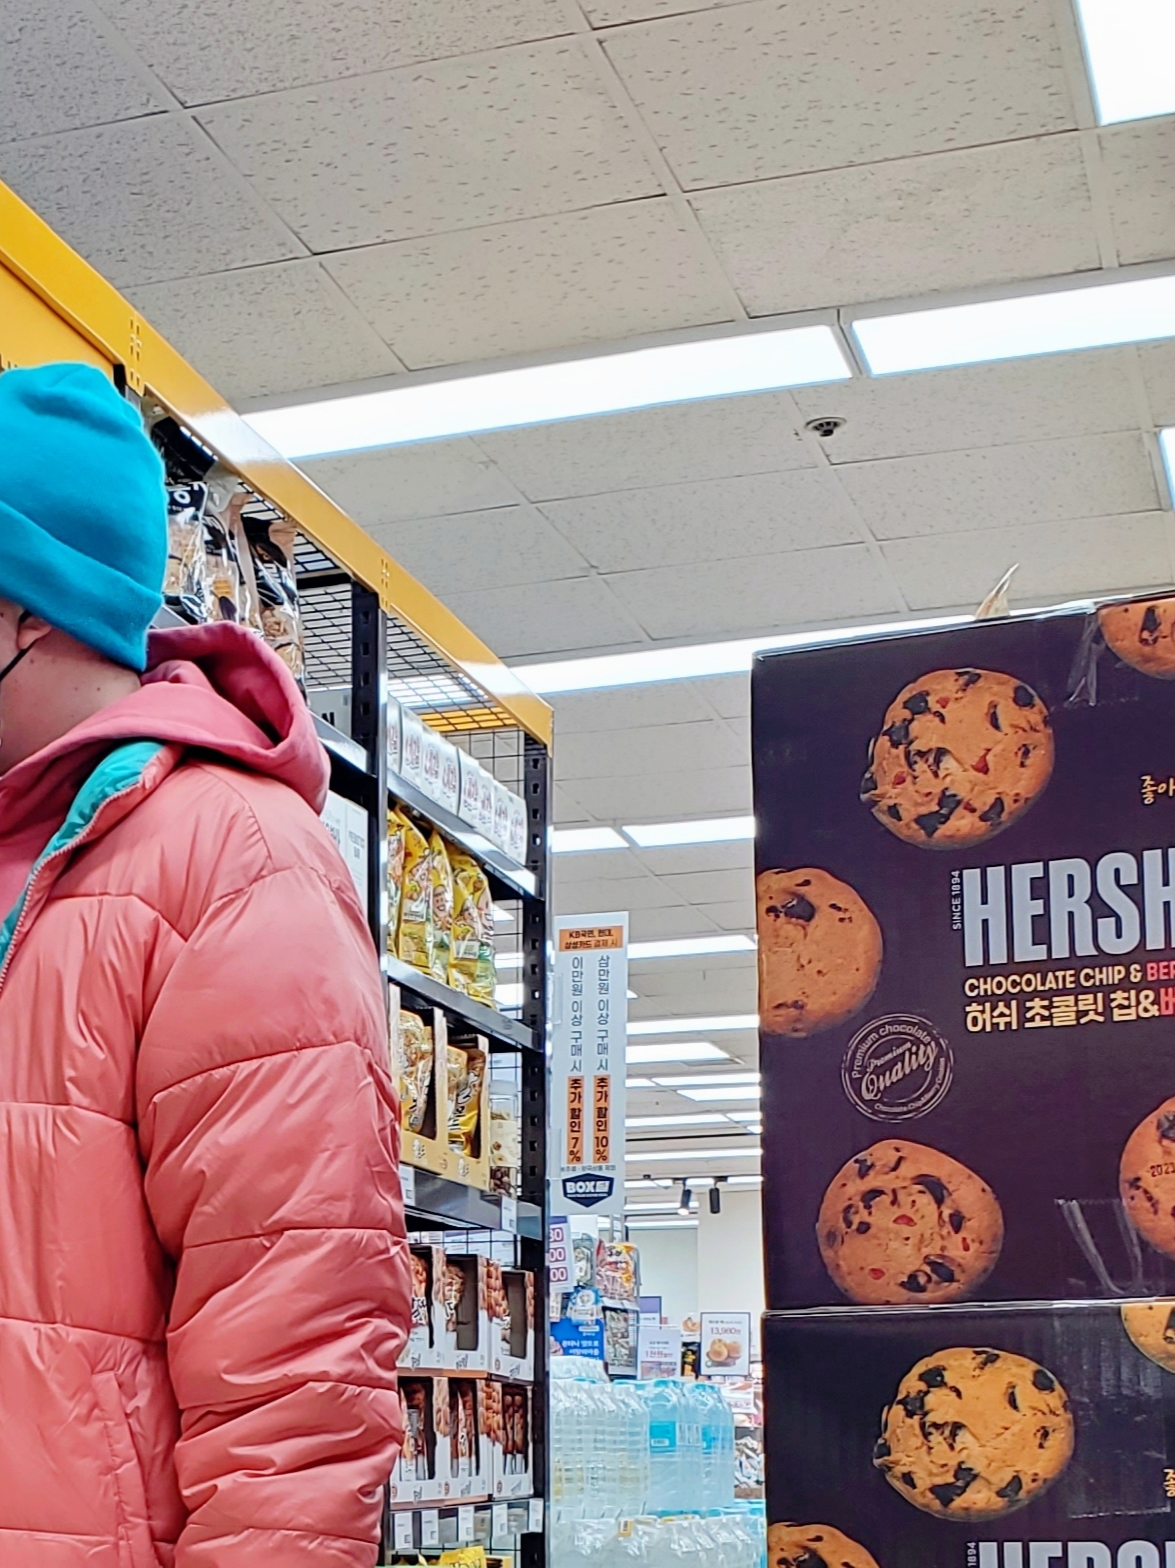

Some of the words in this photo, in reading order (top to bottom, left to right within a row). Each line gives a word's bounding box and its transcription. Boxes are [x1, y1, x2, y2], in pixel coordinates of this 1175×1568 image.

[951, 869, 961, 897] 1894
[952, 896, 962, 931] SINCE
[962, 847, 1175, 968] HERSH
[571, 956, 584, 997] 이만원
[597, 954, 611, 996] 삼만원
[964, 969, 1077, 998] CHOCOLATE
[1079, 963, 1126, 988] CHIP
[1129, 962, 1143, 983] &
[571, 999, 584, 1027] 이상
[597, 998, 610, 1026] 이상
[964, 999, 1019, 1033] 허쉬
[1023, 992, 1105, 1031] 초콜릿
[570, 1030, 583, 1057] 구매
[596, 1029, 609, 1056] 구매
[851, 1032, 880, 1079] Premium
[878, 1023, 932, 1044] chocolate
[570, 1059, 582, 1073] 시
[596, 1058, 609, 1072] 시
[861, 1040, 939, 1101] Quality
[569, 1078, 583, 1104] 추가
[596, 1076, 609, 1103] 추가
[569, 1107, 582, 1134] 할인
[596, 1106, 609, 1132] 할인
[565, 1181, 596, 1194] BOX
[967, 1540, 978, 1568] 1894
